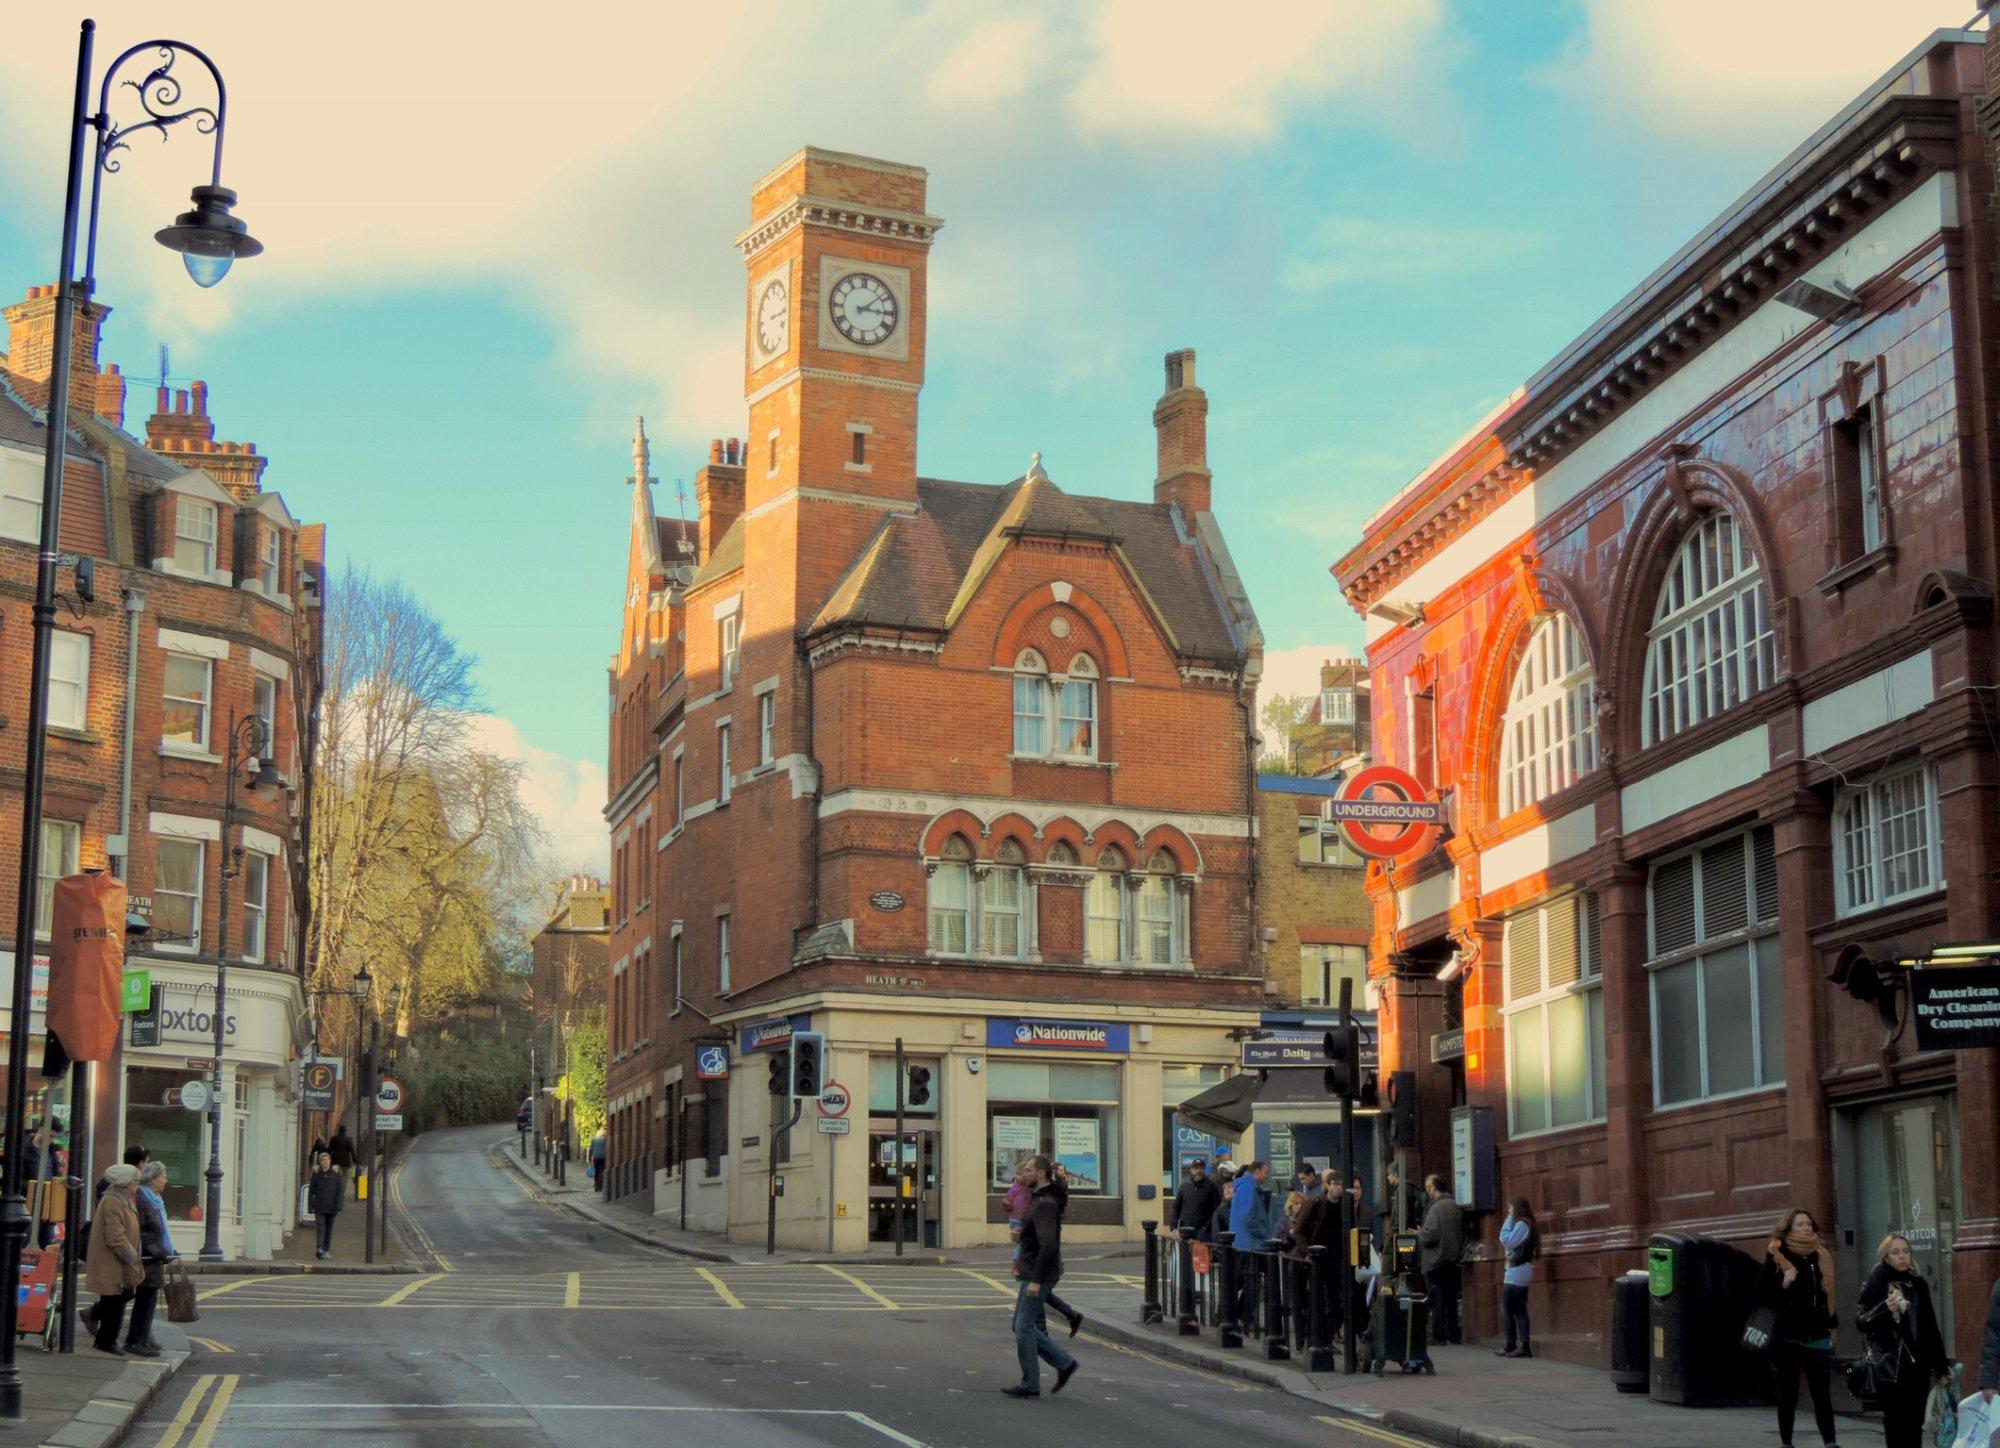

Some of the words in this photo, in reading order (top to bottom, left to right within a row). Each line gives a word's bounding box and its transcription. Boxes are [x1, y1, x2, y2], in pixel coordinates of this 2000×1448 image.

[1335, 804, 1436, 819] UNDERGROUND
[866, 975, 896, 985] HEATH
[1929, 987, 1999, 999] American
[1917, 1004, 1944, 1015] Dry
[1946, 1001, 2000, 1013] Cleanin
[1930, 1018, 2000, 1029] Company
[1032, 1024, 1106, 1042] Nationwide
[1282, 1048, 1311, 1061] Daily
